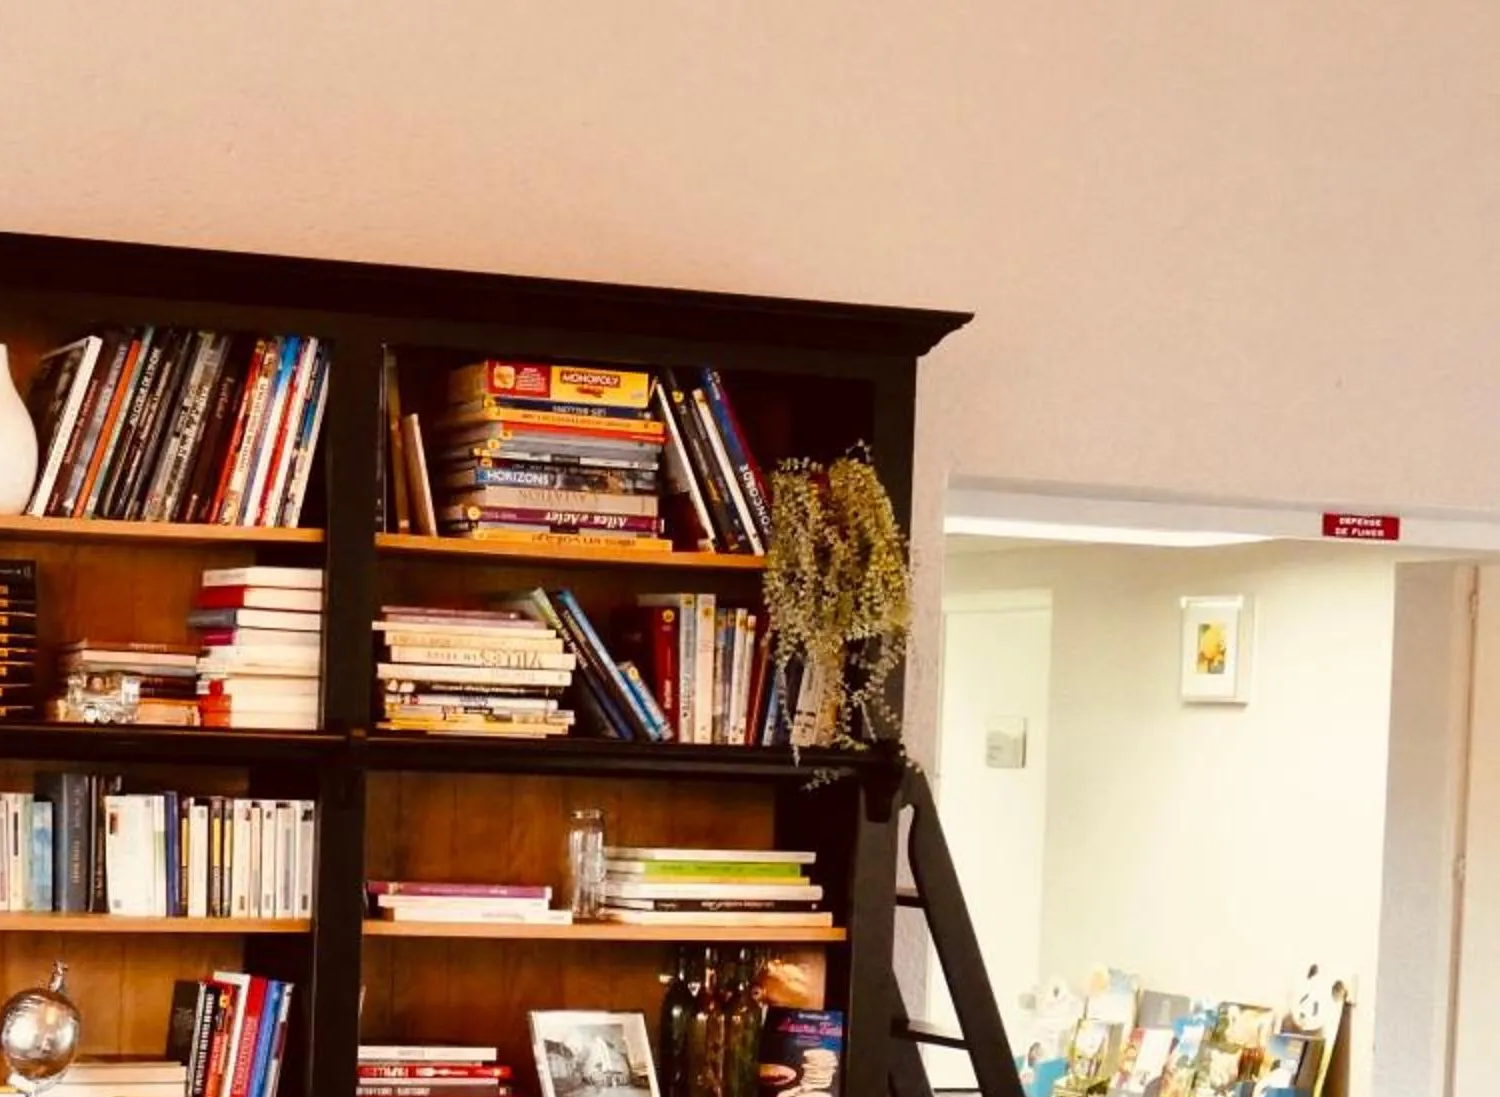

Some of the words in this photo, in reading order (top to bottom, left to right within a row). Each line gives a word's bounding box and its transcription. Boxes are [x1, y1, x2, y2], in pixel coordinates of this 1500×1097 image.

[562, 372, 619, 386] MONOPOLY
[487, 471, 550, 486] HORIZONS
[1334, 527, 1349, 535] DE
